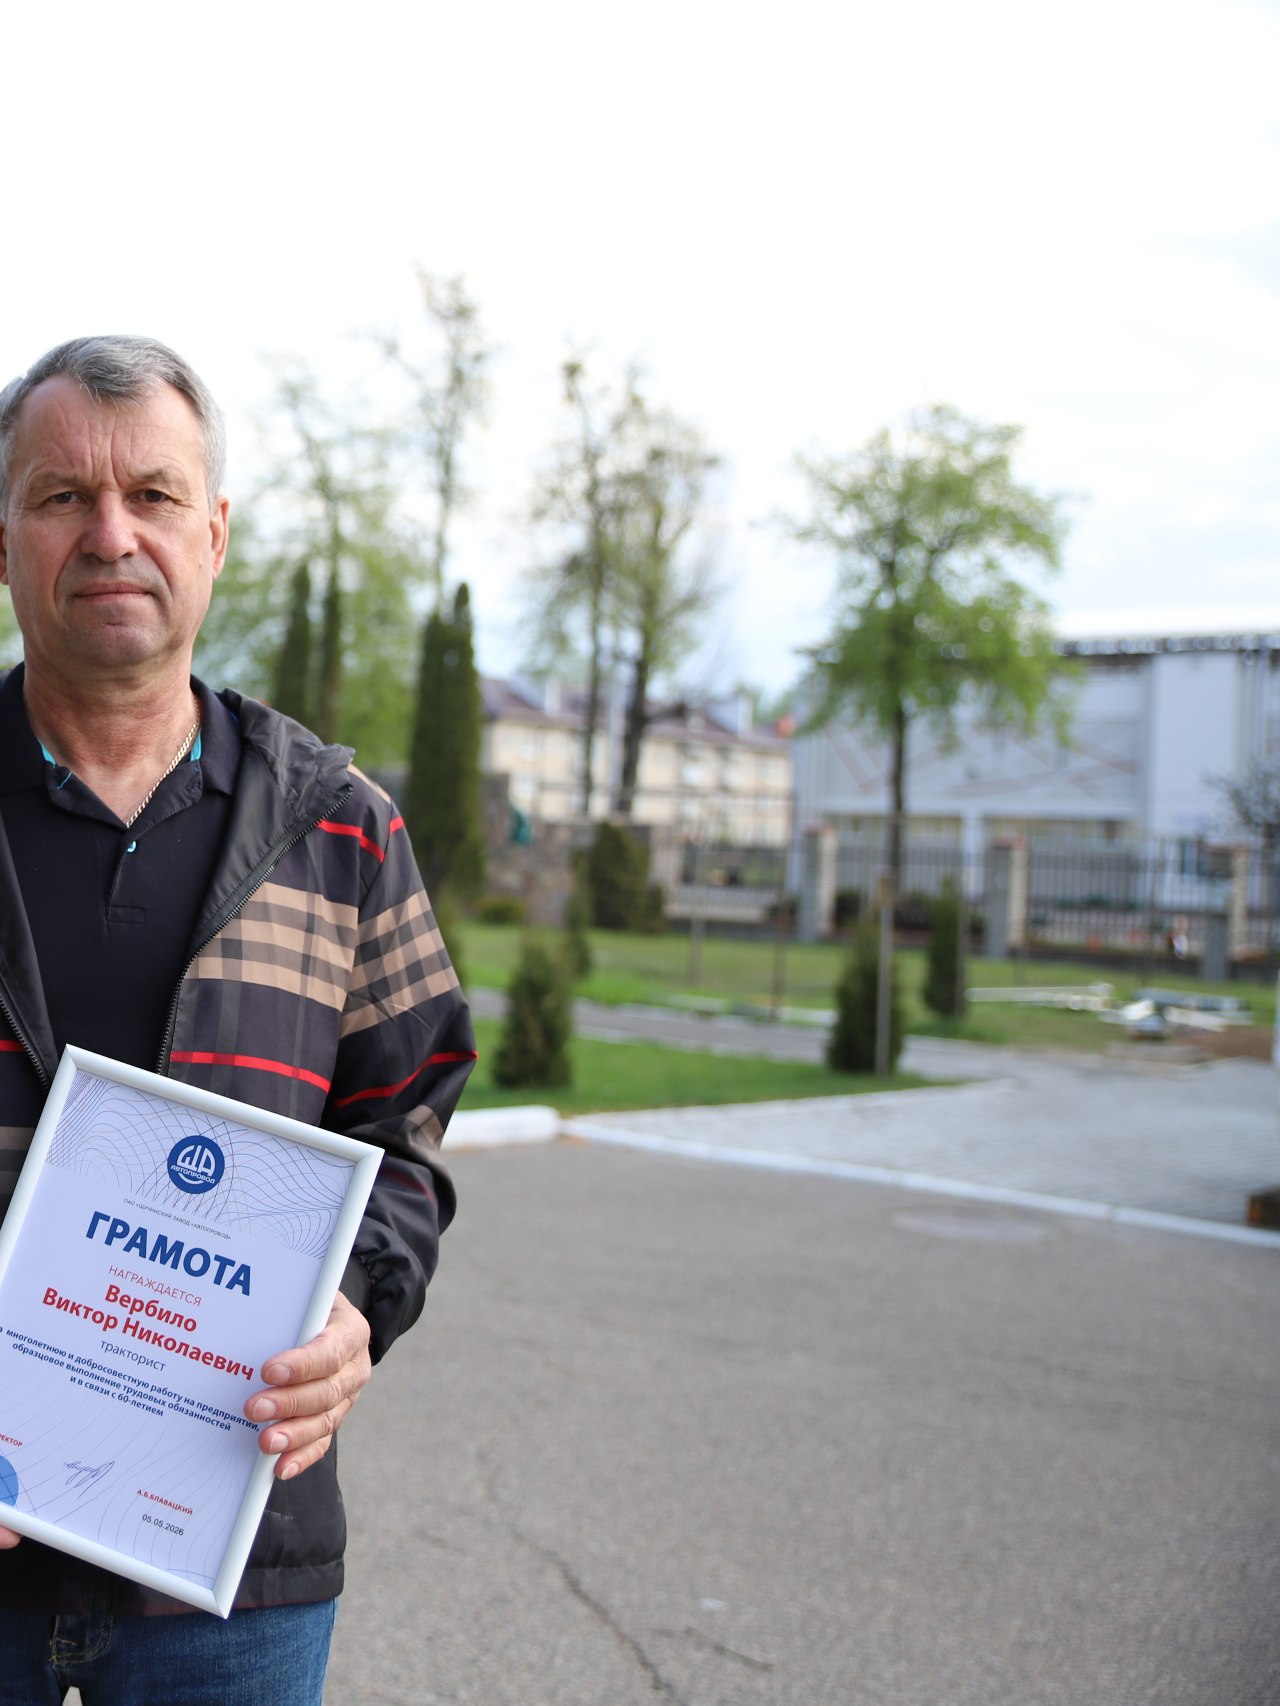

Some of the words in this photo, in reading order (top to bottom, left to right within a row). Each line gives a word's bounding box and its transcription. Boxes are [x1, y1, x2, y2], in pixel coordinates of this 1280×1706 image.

[169, 1164, 215, 1184] АВТОПРОВОД
[123, 1197, 135, 1205] ОАО
[172, 1215, 190, 1226] ЗАВОД
[85, 1210, 251, 1296] ГРАМОТА
[108, 1264, 202, 1307] НАГРАЖДАЕТСЯ
[104, 1283, 197, 1332] Вербило
[42, 1286, 118, 1332] Виктор
[121, 1316, 254, 1381] Николаевич
[100, 1340, 166, 1371] тракторист
[5, 1329, 66, 1357] многолетнюю
[67, 1352, 74, 1360] и
[73, 1355, 149, 1388] добросовестную
[149, 1384, 183, 1402] работу
[183, 1396, 195, 1406] на
[195, 1402, 260, 1432] предприятии,
[12, 1342, 64, 1367] образцовое
[65, 1363, 121, 1389] выполнение
[122, 1384, 166, 1406] трудовых
[167, 1402, 231, 1431] обязанностей
[69, 1375, 76, 1383] и
[84, 1381, 110, 1396] связи
[117, 1392, 163, 1416] 60-летием
[136, 1488, 193, 1515] А.Б.БЛАВАЦКИЙ
[141, 1513, 184, 1536] 05.05.2026
